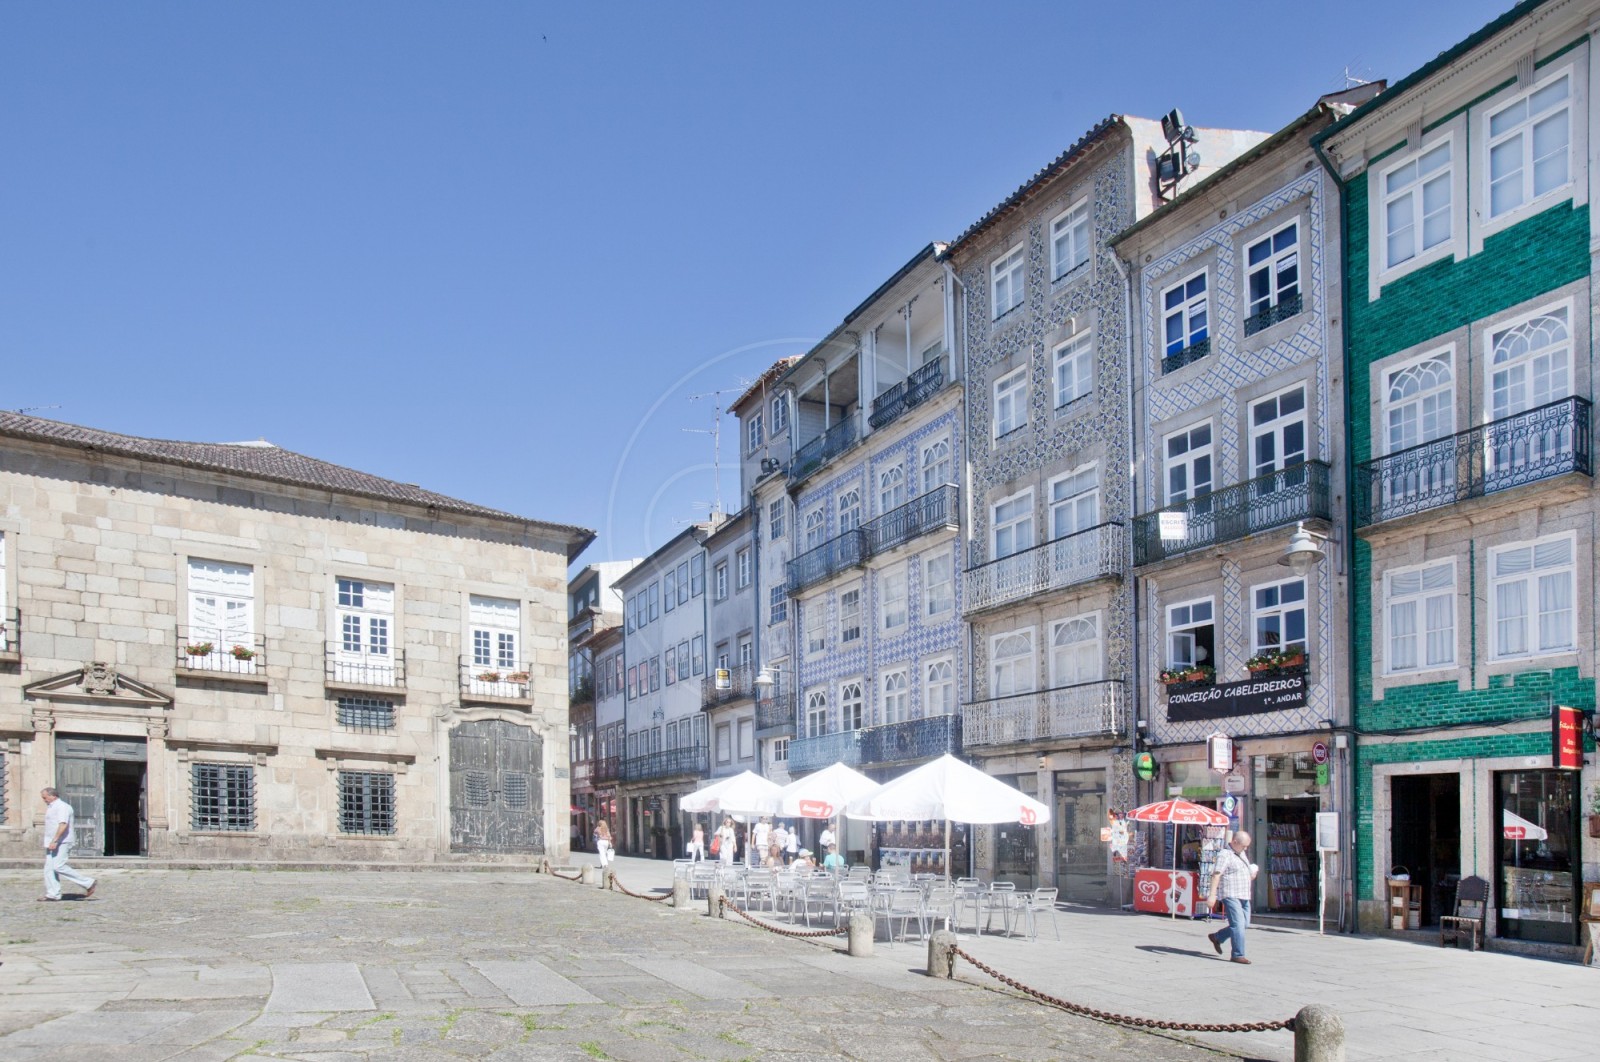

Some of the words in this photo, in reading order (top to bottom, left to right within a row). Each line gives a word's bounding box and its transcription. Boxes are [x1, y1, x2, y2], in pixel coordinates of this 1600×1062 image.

[1169, 687, 1222, 704] CONCEIÇÃO
[1224, 677, 1302, 697] CABELEIREIROS
[1276, 692, 1303, 704] ANDAR
